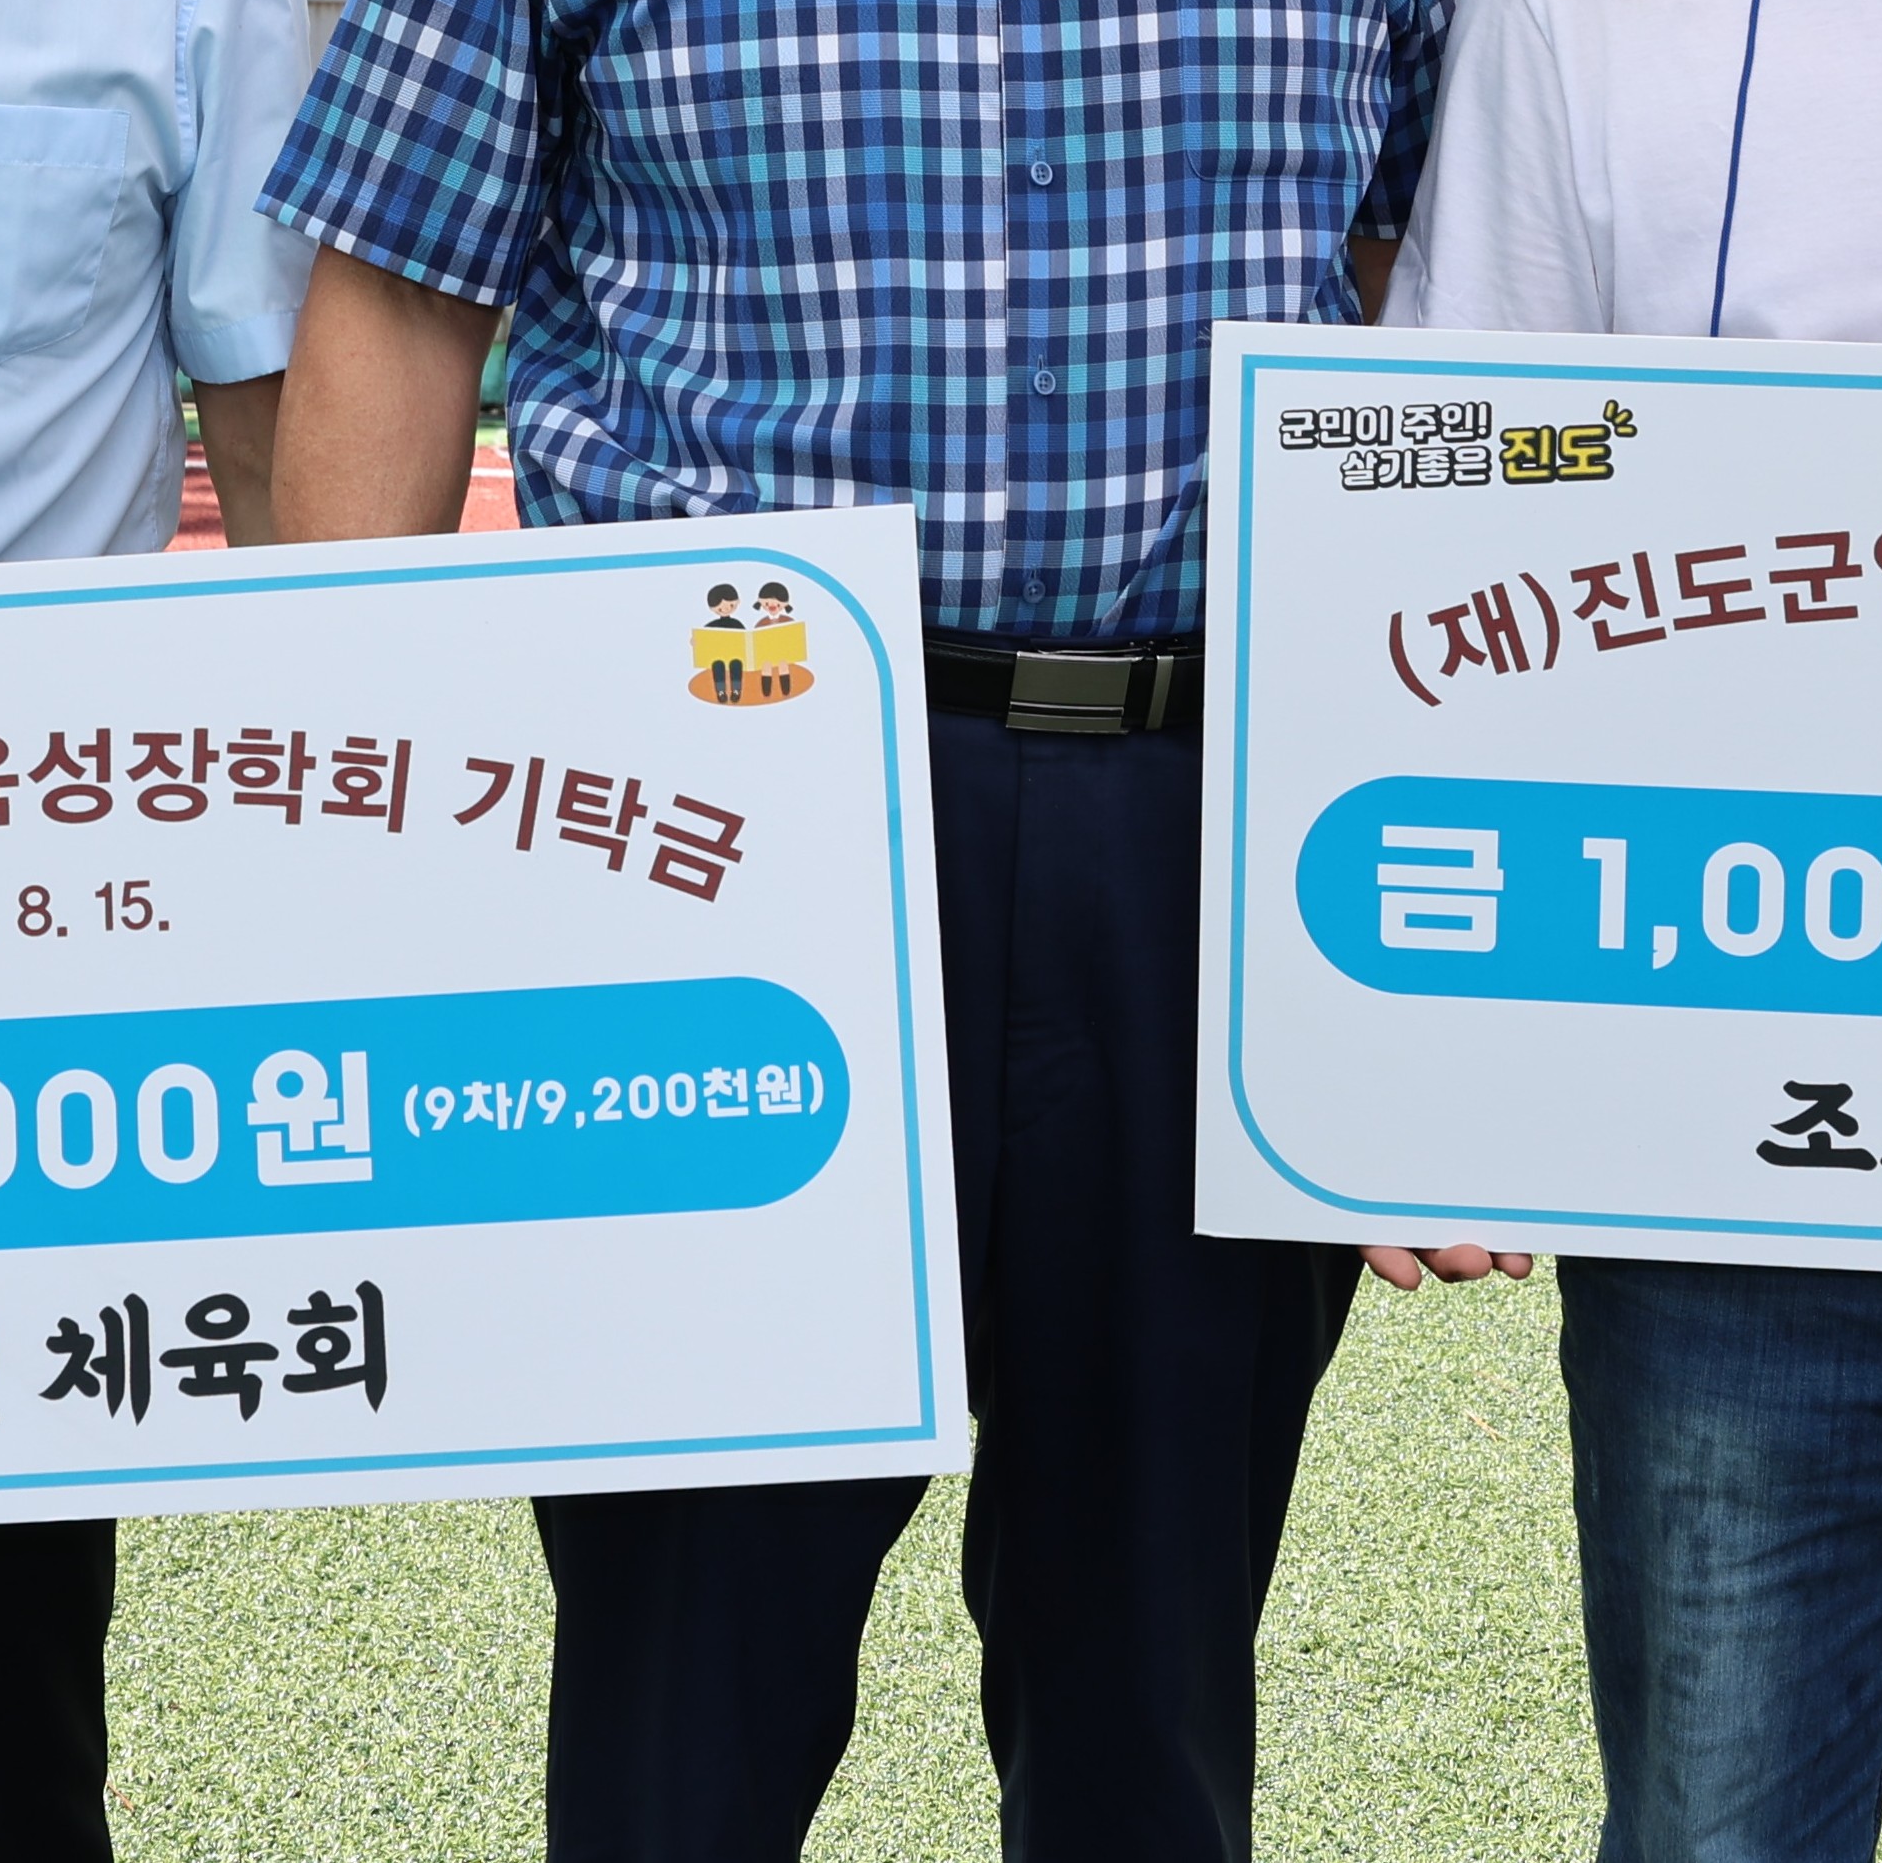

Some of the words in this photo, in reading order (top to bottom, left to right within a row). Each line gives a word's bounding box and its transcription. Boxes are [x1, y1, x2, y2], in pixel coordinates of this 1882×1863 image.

[1279, 405, 1393, 450] 군민이
[1401, 401, 1492, 445] 주인!
[1340, 445, 1492, 491] 살기좋은
[1499, 424, 1614, 486] 진도
[454, 756, 748, 903] 기탁금
[18, 883, 69, 939] 8.
[93, 879, 172, 934] 15.
[1375, 823, 1506, 954] 금
[402, 1060, 826, 1140] (9차/9,200천원)
[37, 1279, 390, 1427] 체육회
